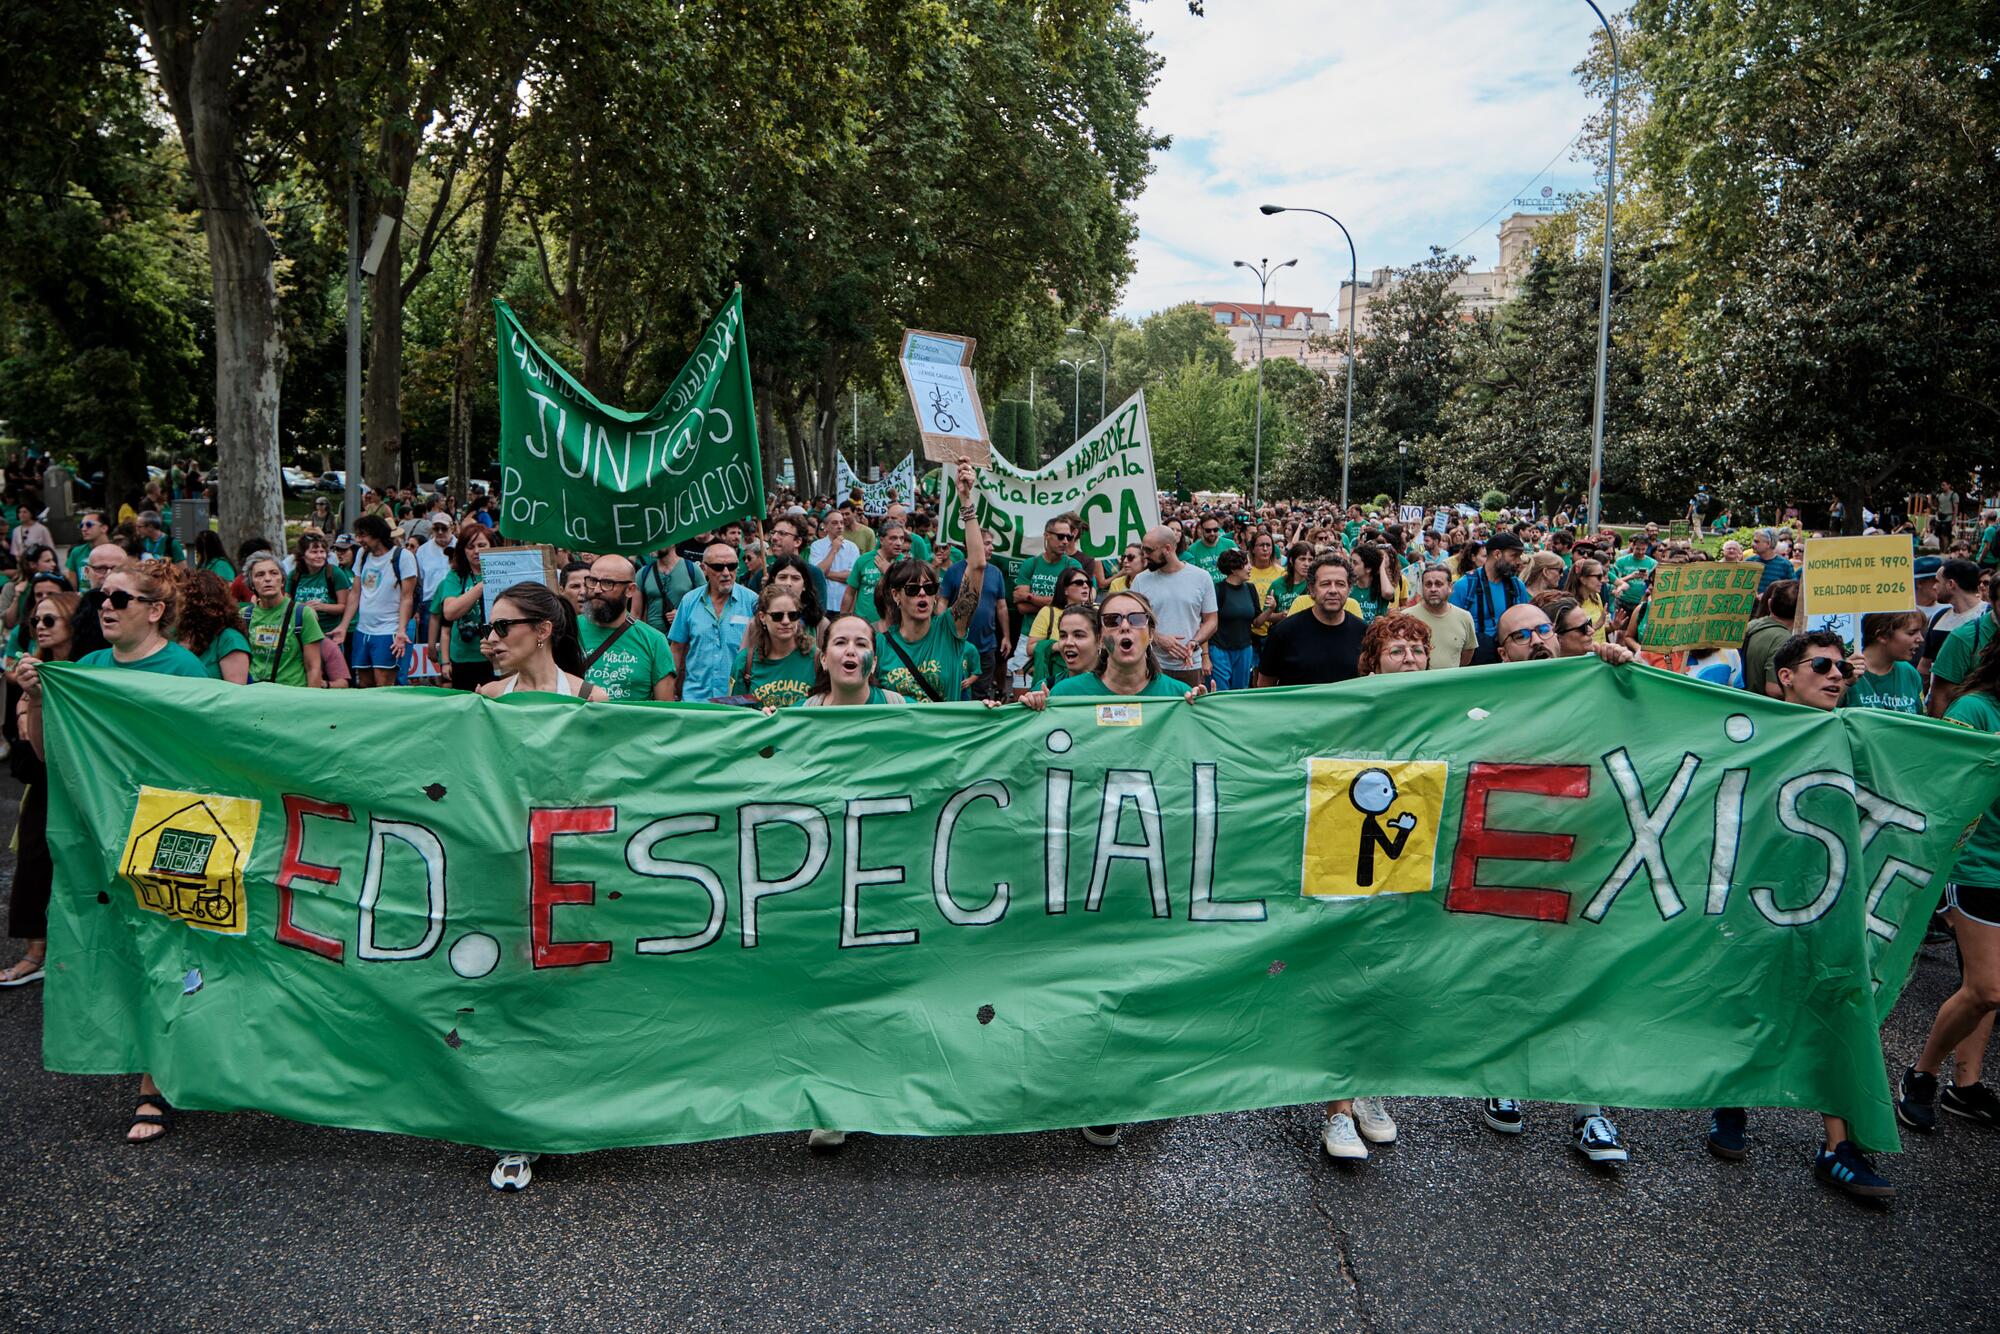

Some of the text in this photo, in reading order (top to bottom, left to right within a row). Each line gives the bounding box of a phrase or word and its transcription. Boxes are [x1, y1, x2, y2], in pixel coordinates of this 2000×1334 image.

[1066, 403, 1141, 479] MÁRQUEZ
[1121, 453, 1145, 478] la
[501, 466, 549, 525] Por
[562, 488, 597, 544] la
[1808, 556, 1910, 570] NORMATIVA DE 1990.
[1813, 582, 1906, 596] REALIDAD DE 2026
[274, 793, 501, 980] ED.
